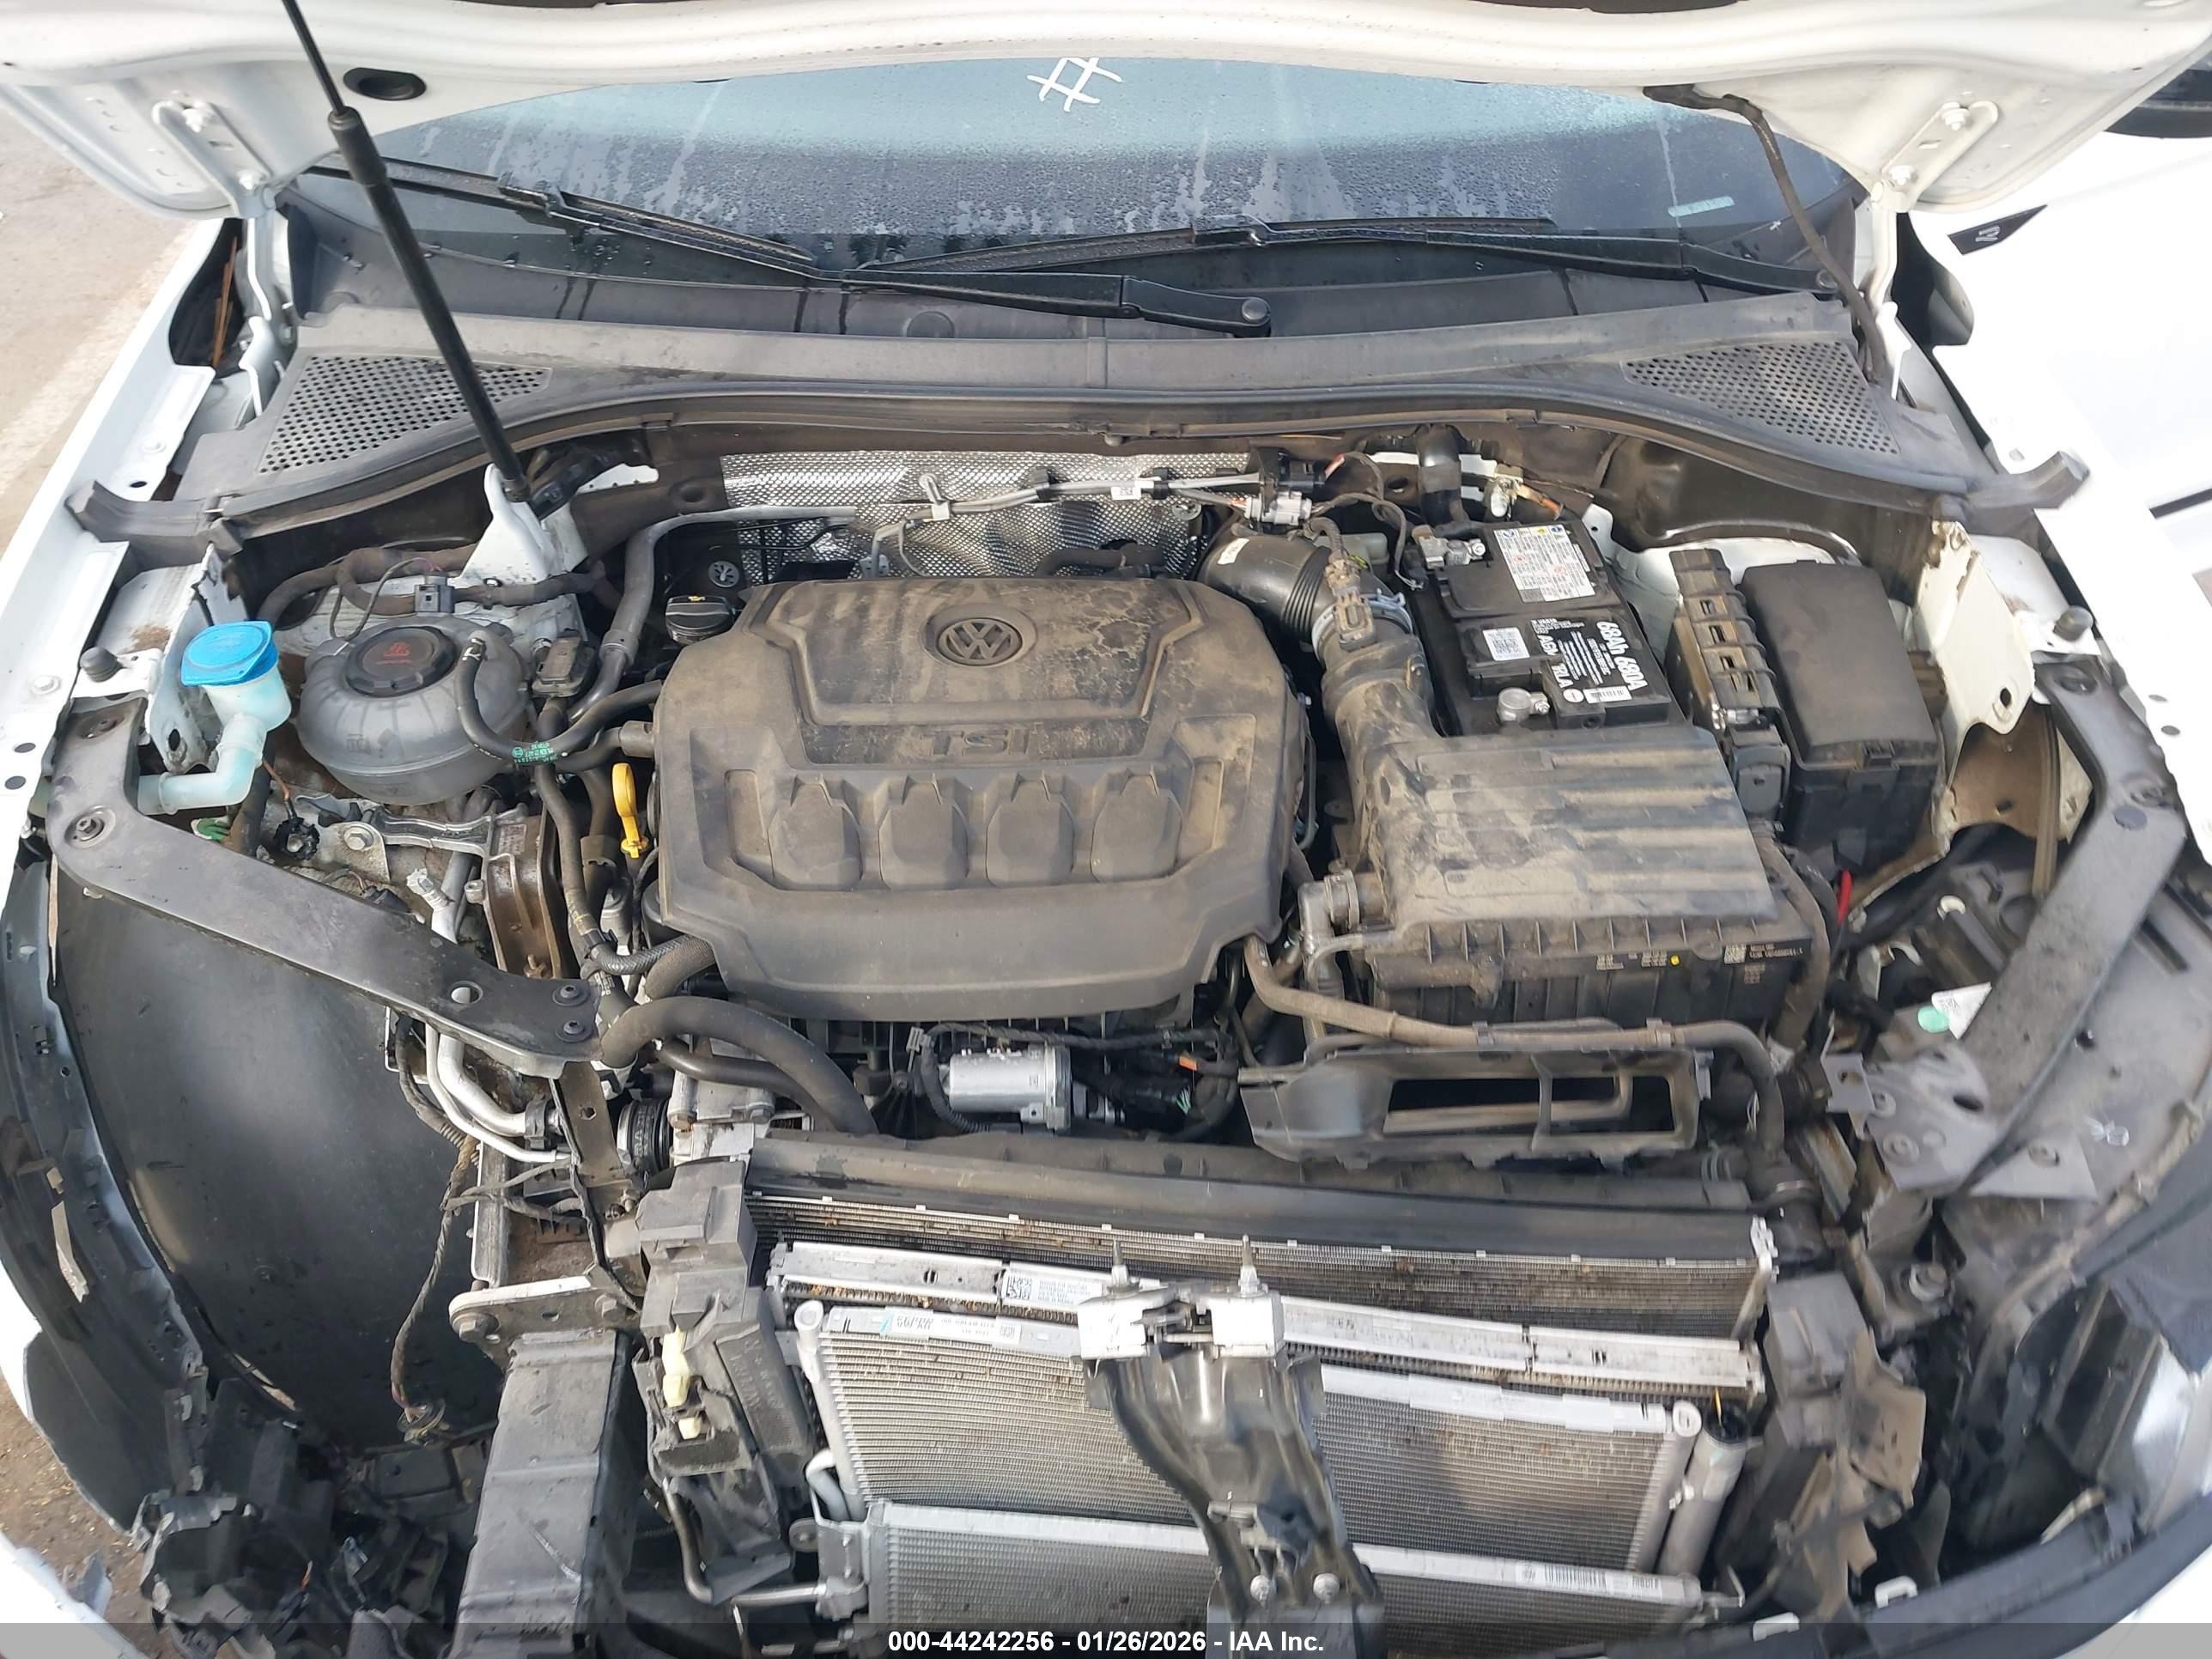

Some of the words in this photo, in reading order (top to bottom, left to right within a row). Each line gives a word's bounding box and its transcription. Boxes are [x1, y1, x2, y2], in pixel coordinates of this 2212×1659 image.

[1596, 621, 1629, 655] 68Ah
[1614, 656, 1649, 690] 680A
[921, 730, 1029, 757] TSI
